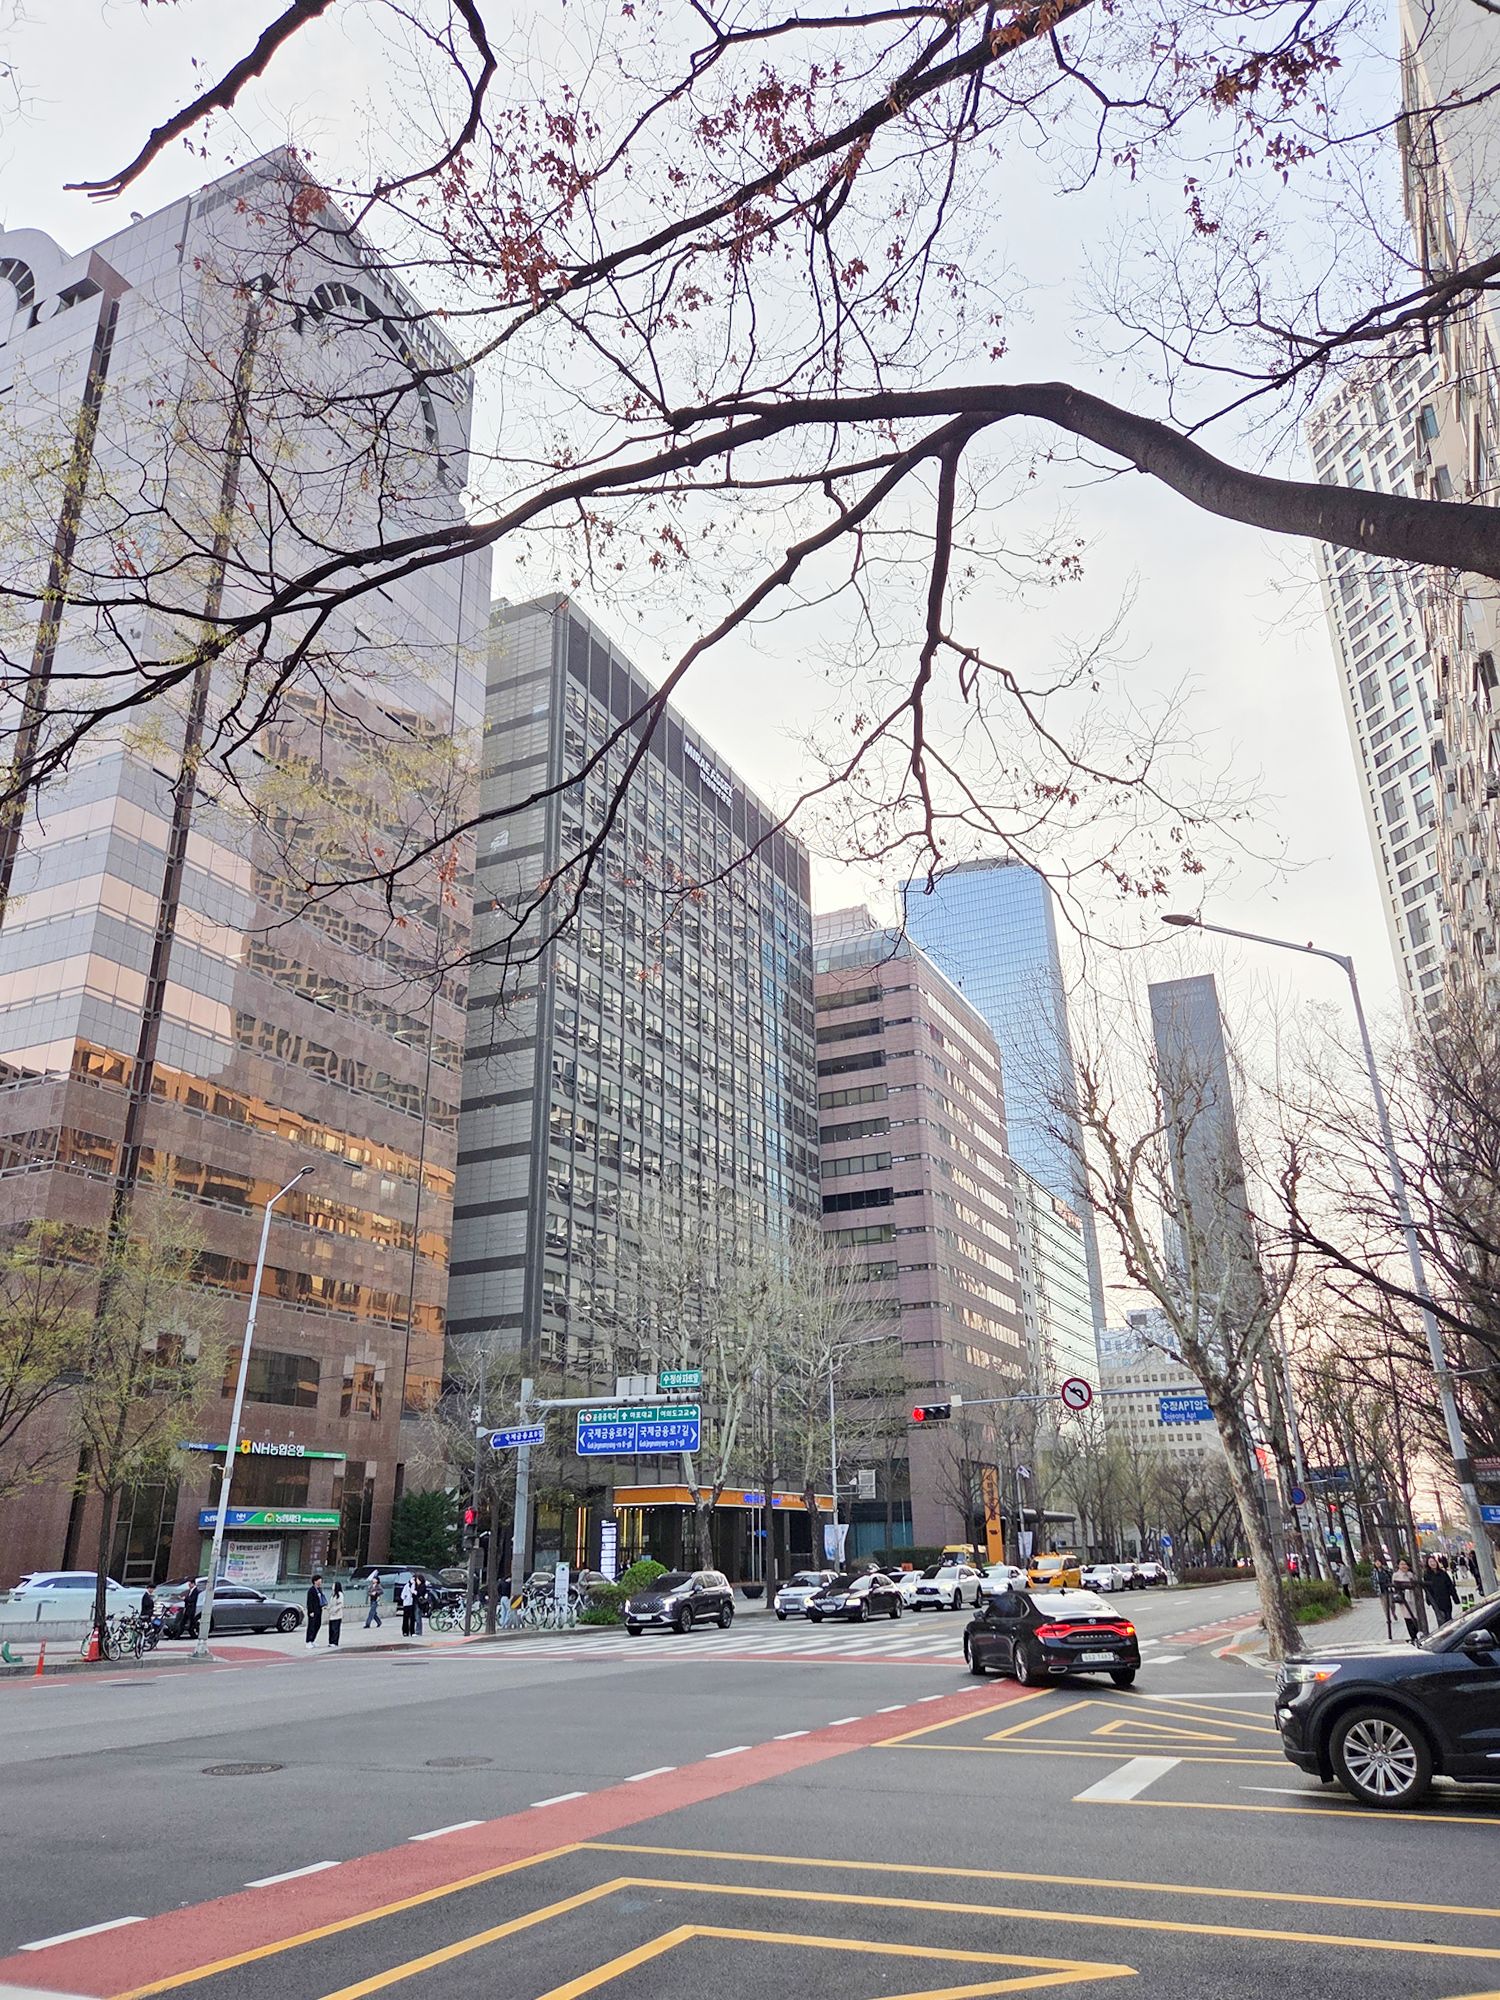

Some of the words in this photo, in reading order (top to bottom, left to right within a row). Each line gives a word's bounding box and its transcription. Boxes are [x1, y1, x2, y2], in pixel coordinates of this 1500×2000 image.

[587, 1427, 635, 1440] 국제금융로8길
[640, 1424, 689, 1438] 국제금융로7길
[251, 1442, 305, 1458] NH농협은행
